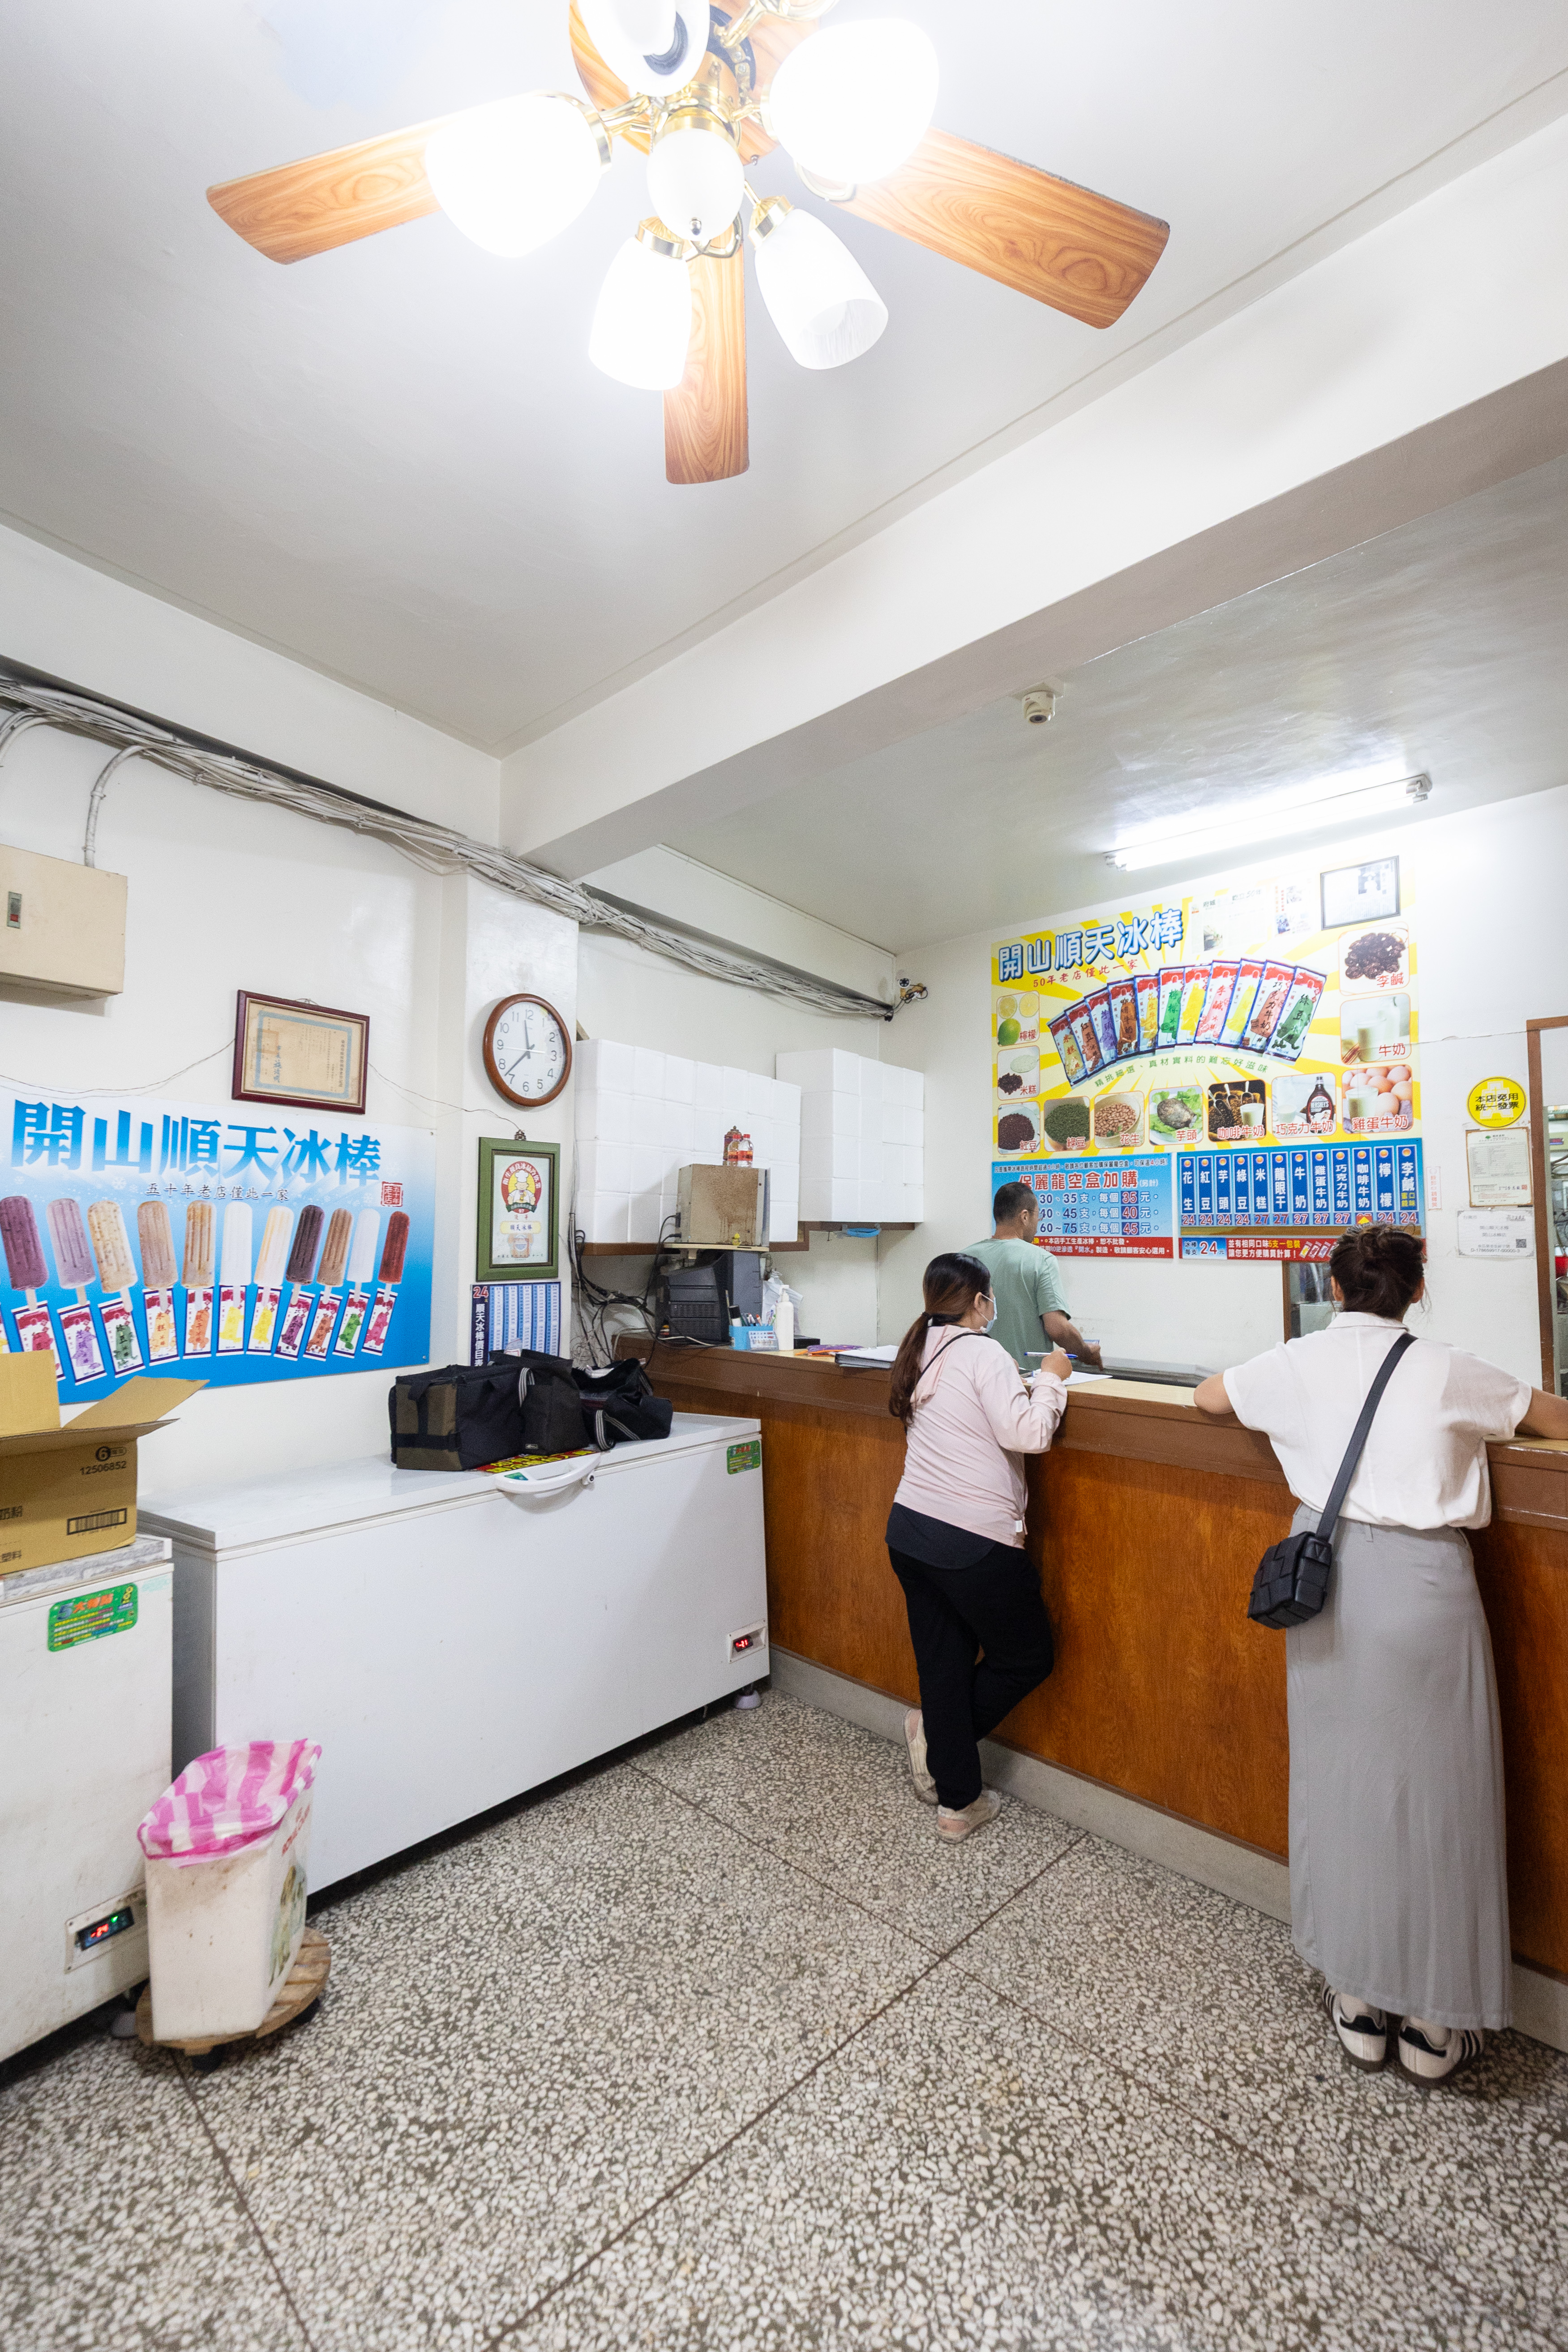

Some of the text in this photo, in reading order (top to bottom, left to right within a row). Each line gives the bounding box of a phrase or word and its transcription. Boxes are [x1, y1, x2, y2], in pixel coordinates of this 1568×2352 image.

[998, 908, 1183, 982] 開山順天冰棒
[1033, 959, 1139, 988] 50年老店僅此一家
[1377, 972, 1403, 987] 李鹹
[512, 1011, 519, 1022] 11
[525, 1009, 534, 1020] 12
[500, 1022, 509, 1034] 10
[549, 1032, 556, 1042] 2
[1020, 1029, 1037, 1041] 檸檬
[497, 1039, 504, 1050] 9
[1379, 1043, 1405, 1057] 牛奶
[550, 1050, 557, 1061] 3
[498, 1058, 506, 1070] 8
[508, 1073, 515, 1084] 7
[547, 1068, 553, 1079] 4
[523, 1081, 529, 1092] 6
[537, 1079, 543, 1089] 5
[1020, 1085, 1037, 1096] 米糕
[1475, 1093, 1519, 1102] 本店免用
[1475, 1101, 1519, 1111] 統一發票
[1276, 1120, 1333, 1135] 巧克力牛奶
[1352, 1114, 1408, 1131] 雞蛋牛奶
[1120, 1133, 1140, 1144] 花生
[1176, 1129, 1197, 1141] 芋頭
[1217, 1126, 1264, 1139] 咖啡牛奶
[12, 1099, 382, 1187] 開山順天冰棒
[1020, 1140, 1037, 1151] 紅豆
[1067, 1137, 1086, 1148] 綠豆
[1019, 1170, 1138, 1191] 保麗龍空盒加購
[1401, 1161, 1415, 1191] 李鹹
[1200, 1171, 1211, 1210] 紅豆
[1218, 1170, 1229, 1210] 芋頭
[1237, 1169, 1247, 1209] 綠豆
[1255, 1168, 1267, 1209] 米糕
[1275, 1167, 1286, 1209] 龍眼干
[1294, 1166, 1306, 1208] 牛奶
[1315, 1165, 1327, 1208] 雞蛋牛奶
[1336, 1164, 1348, 1208] 巧克力牛奶
[1357, 1163, 1370, 1208] 咖啡牛奶
[1379, 1162, 1392, 1207] 檸檬
[146, 1182, 289, 1202] 五十年老店僅此一家
[1183, 1172, 1193, 1210] 花生
[1182, 1215, 1195, 1225] 24
[1200, 1215, 1212, 1225] 24
[1217, 1215, 1231, 1225] 24
[1236, 1214, 1250, 1225] 24
[1255, 1214, 1269, 1225] 27
[1273, 1214, 1288, 1225] 27
[1294, 1214, 1308, 1225] 27
[1314, 1213, 1328, 1224] 27
[1335, 1213, 1350, 1224] 27
[1378, 1212, 1394, 1224] 24
[1400, 1212, 1417, 1224] 24
[1200, 1241, 1217, 1255] 24
[473, 1286, 489, 1298] 24
[474, 1303, 485, 1367] 順天冰棒價目表
